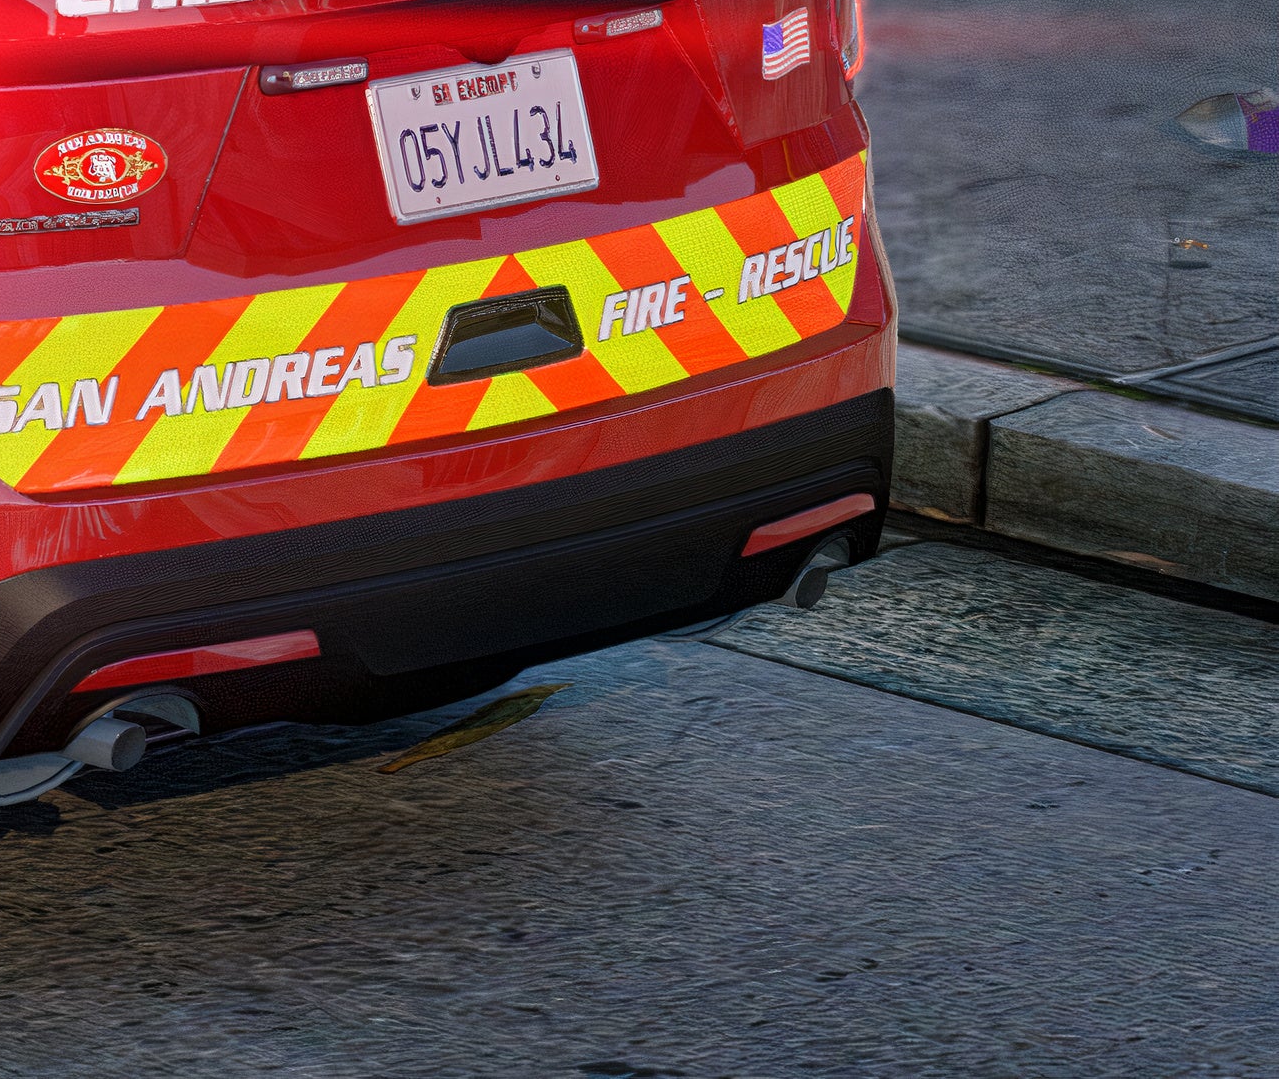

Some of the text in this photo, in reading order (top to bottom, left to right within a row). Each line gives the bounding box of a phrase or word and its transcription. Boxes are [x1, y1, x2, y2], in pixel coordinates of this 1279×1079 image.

[398, 100, 579, 194] 05YJL434
[134, 334, 418, 421] ANDREAS
[597, 273, 692, 342] FIRE
[737, 214, 855, 304] RESCUE
